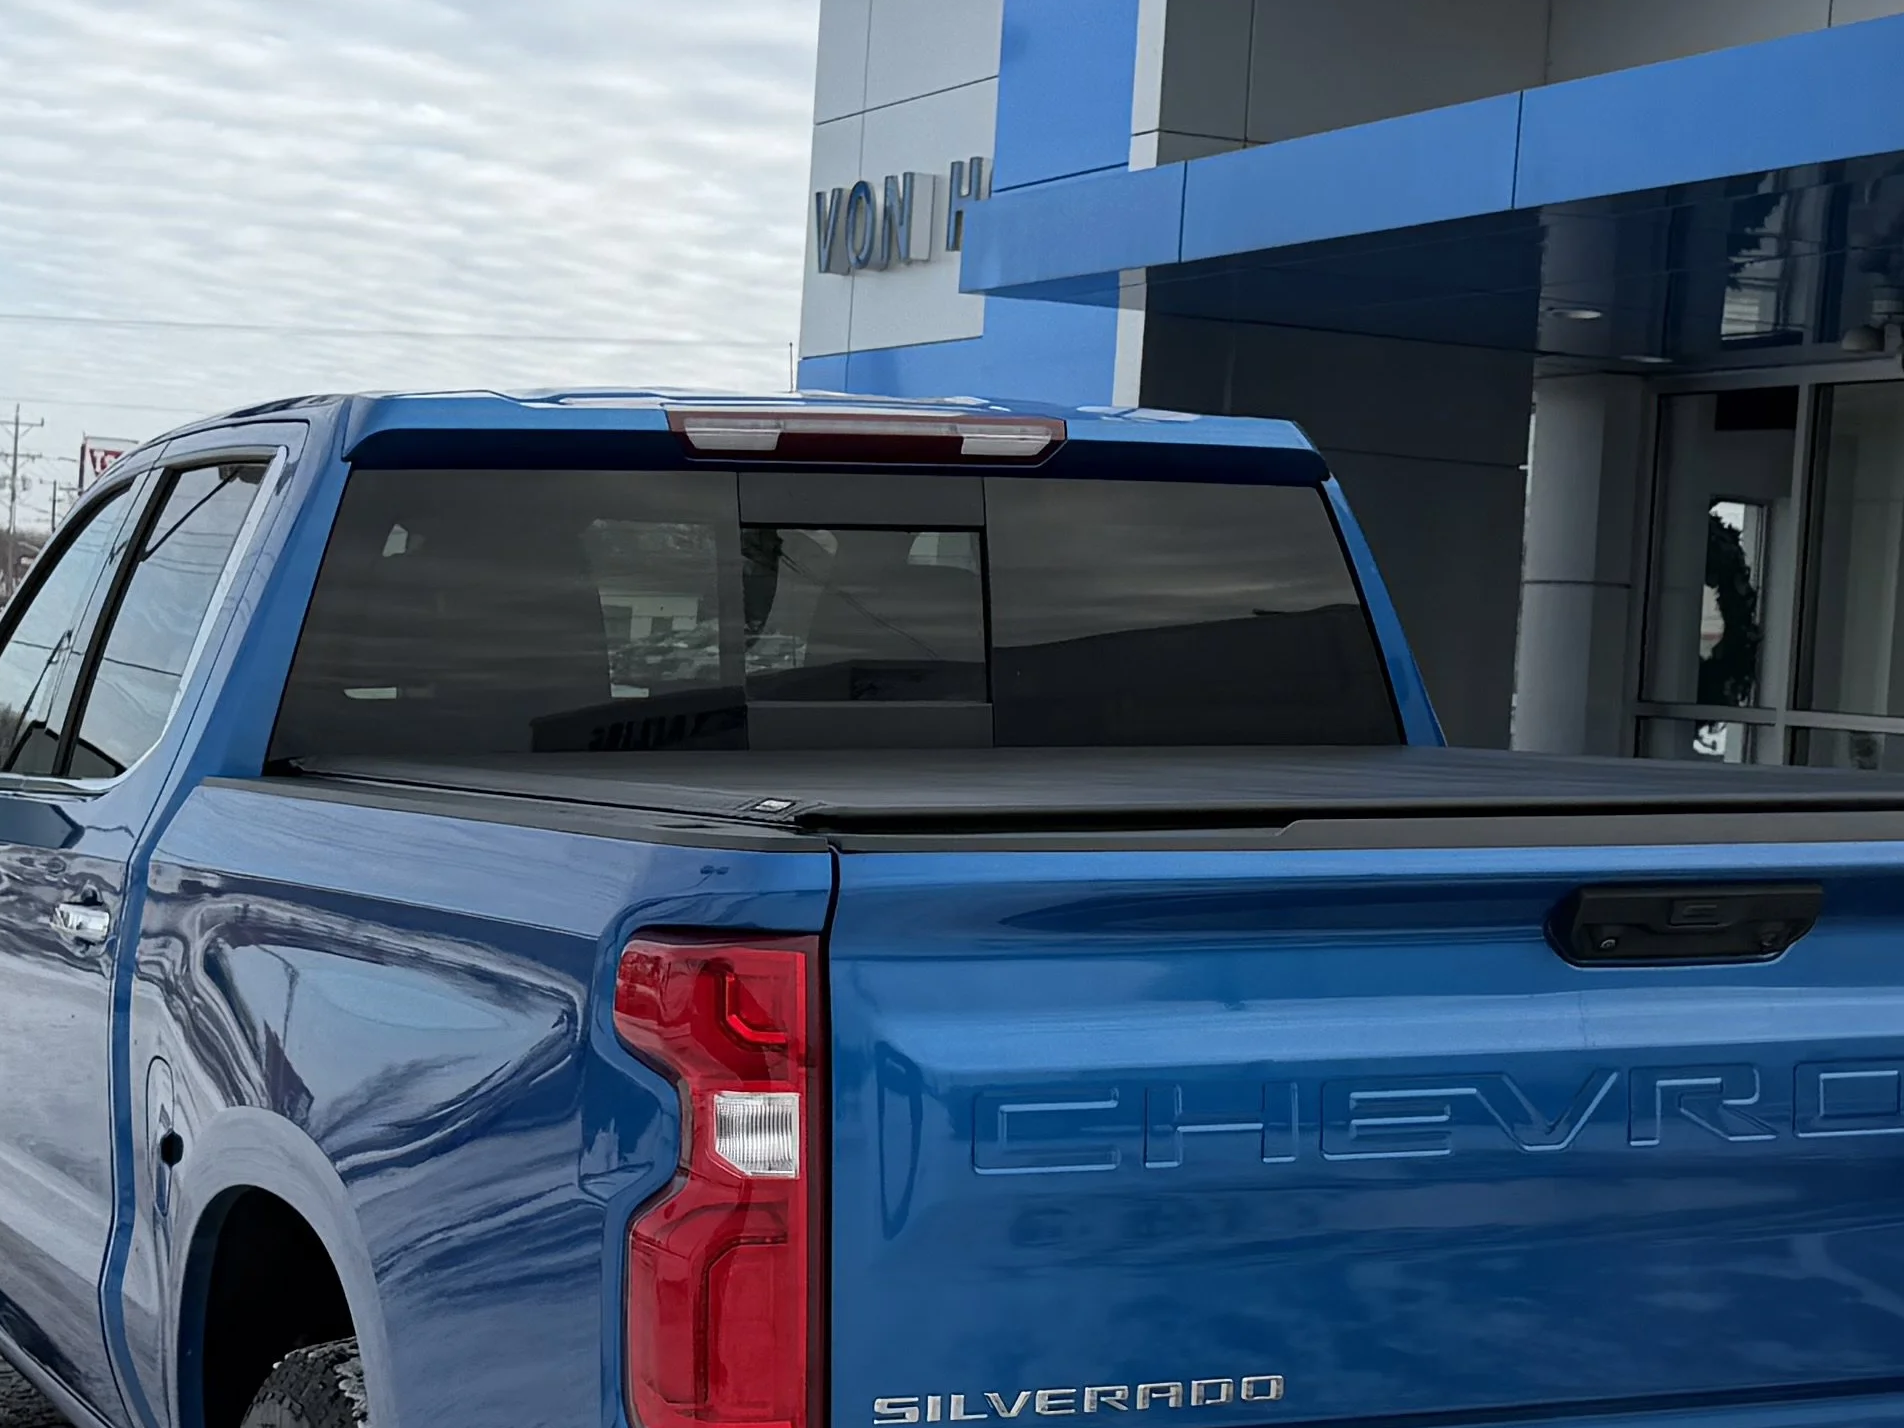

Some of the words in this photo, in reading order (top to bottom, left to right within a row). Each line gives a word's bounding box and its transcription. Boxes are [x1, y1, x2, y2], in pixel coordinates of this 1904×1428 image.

[815, 171, 916, 274] VON
[946, 156, 993, 252] H
[873, 1374, 1285, 1425] SILVERADO
